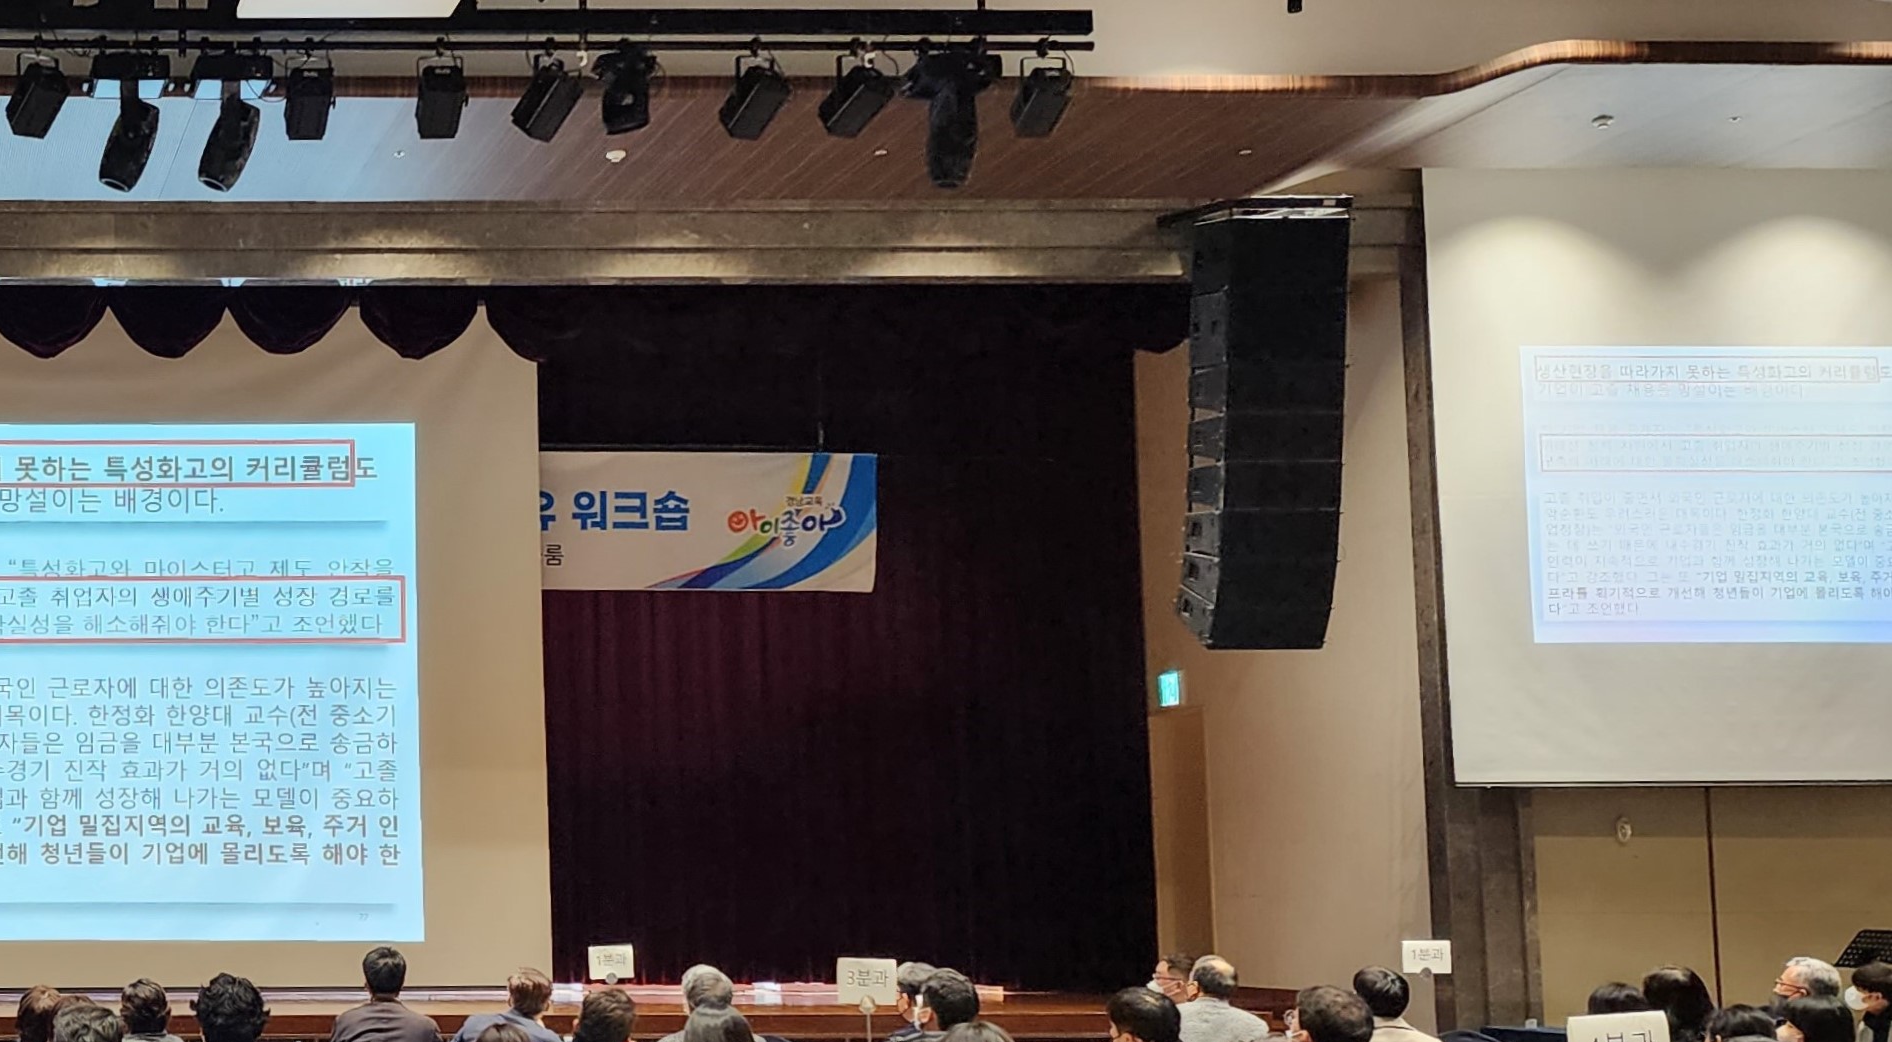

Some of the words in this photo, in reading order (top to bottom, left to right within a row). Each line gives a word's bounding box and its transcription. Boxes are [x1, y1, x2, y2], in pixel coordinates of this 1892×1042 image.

[14, 455, 92, 480] 못하는
[103, 455, 233, 480] 특성화고의
[0, 488, 102, 514] 망설이는
[115, 488, 223, 514] 배경이다.
[572, 490, 690, 531] 워크숍
[48, 676, 136, 699] 근로자에
[150, 676, 193, 699] 대한
[204, 676, 295, 699] 의존도가
[306, 676, 396, 699] 높아지는
[88, 704, 155, 728] 한정화
[166, 704, 231, 728] 한양대
[244, 704, 316, 728] 교수(전
[329, 704, 395, 728] 중소기
[76, 732, 143, 756] 임금을
[153, 732, 219, 756] 대부분
[229, 732, 320, 756] 본국으로
[330, 732, 398, 756] 송금하
[65, 759, 107, 782] 진작
[120, 759, 187, 782] 효과가
[200, 759, 242, 782] 거의
[40, 787, 82, 810] 함께
[95, 787, 161, 810] 성장해
[175, 787, 240, 810] 나가는
[251, 787, 318, 810] 모델이
[331, 787, 399, 810] 중요하
[79, 814, 190, 838] 밀집지역의
[201, 814, 251, 838] 교육,
[262, 814, 312, 838] 보육,
[323, 814, 366, 838] 주거
[379, 814, 398, 838] 인
[41, 842, 128, 866] 청년들이
[142, 842, 208, 866] 기업에
[221, 842, 311, 866] 몰리도록
[322, 842, 369, 866] 해야
[379, 842, 401, 866] 한
[846, 969, 889, 988] 3분과
